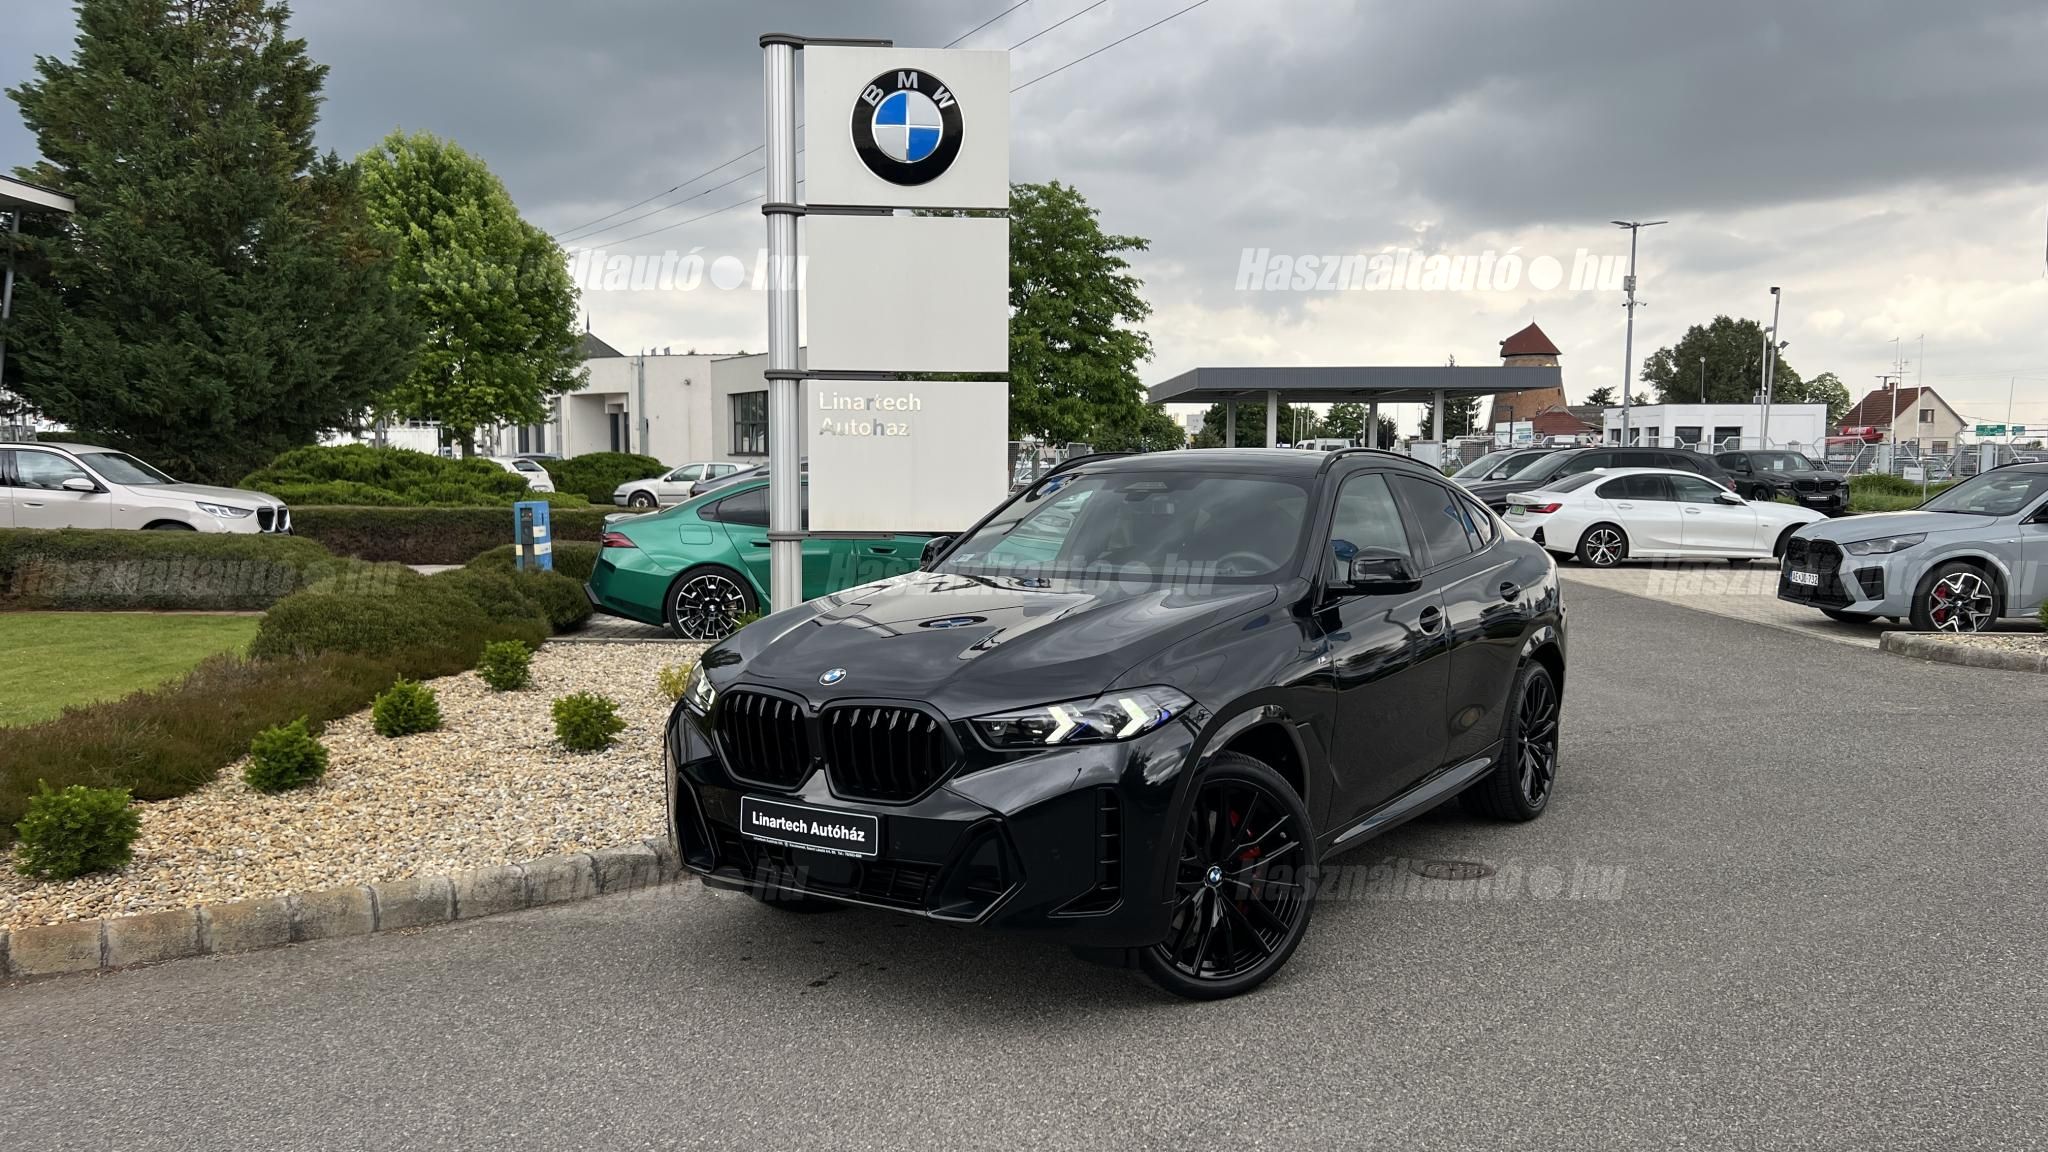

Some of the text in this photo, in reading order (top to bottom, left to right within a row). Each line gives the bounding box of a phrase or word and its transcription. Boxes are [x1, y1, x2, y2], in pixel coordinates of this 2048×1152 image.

[861, 71, 956, 109] BMW
[819, 391, 921, 411] Linartech
[752, 811, 865, 842] Linartech Autóház
